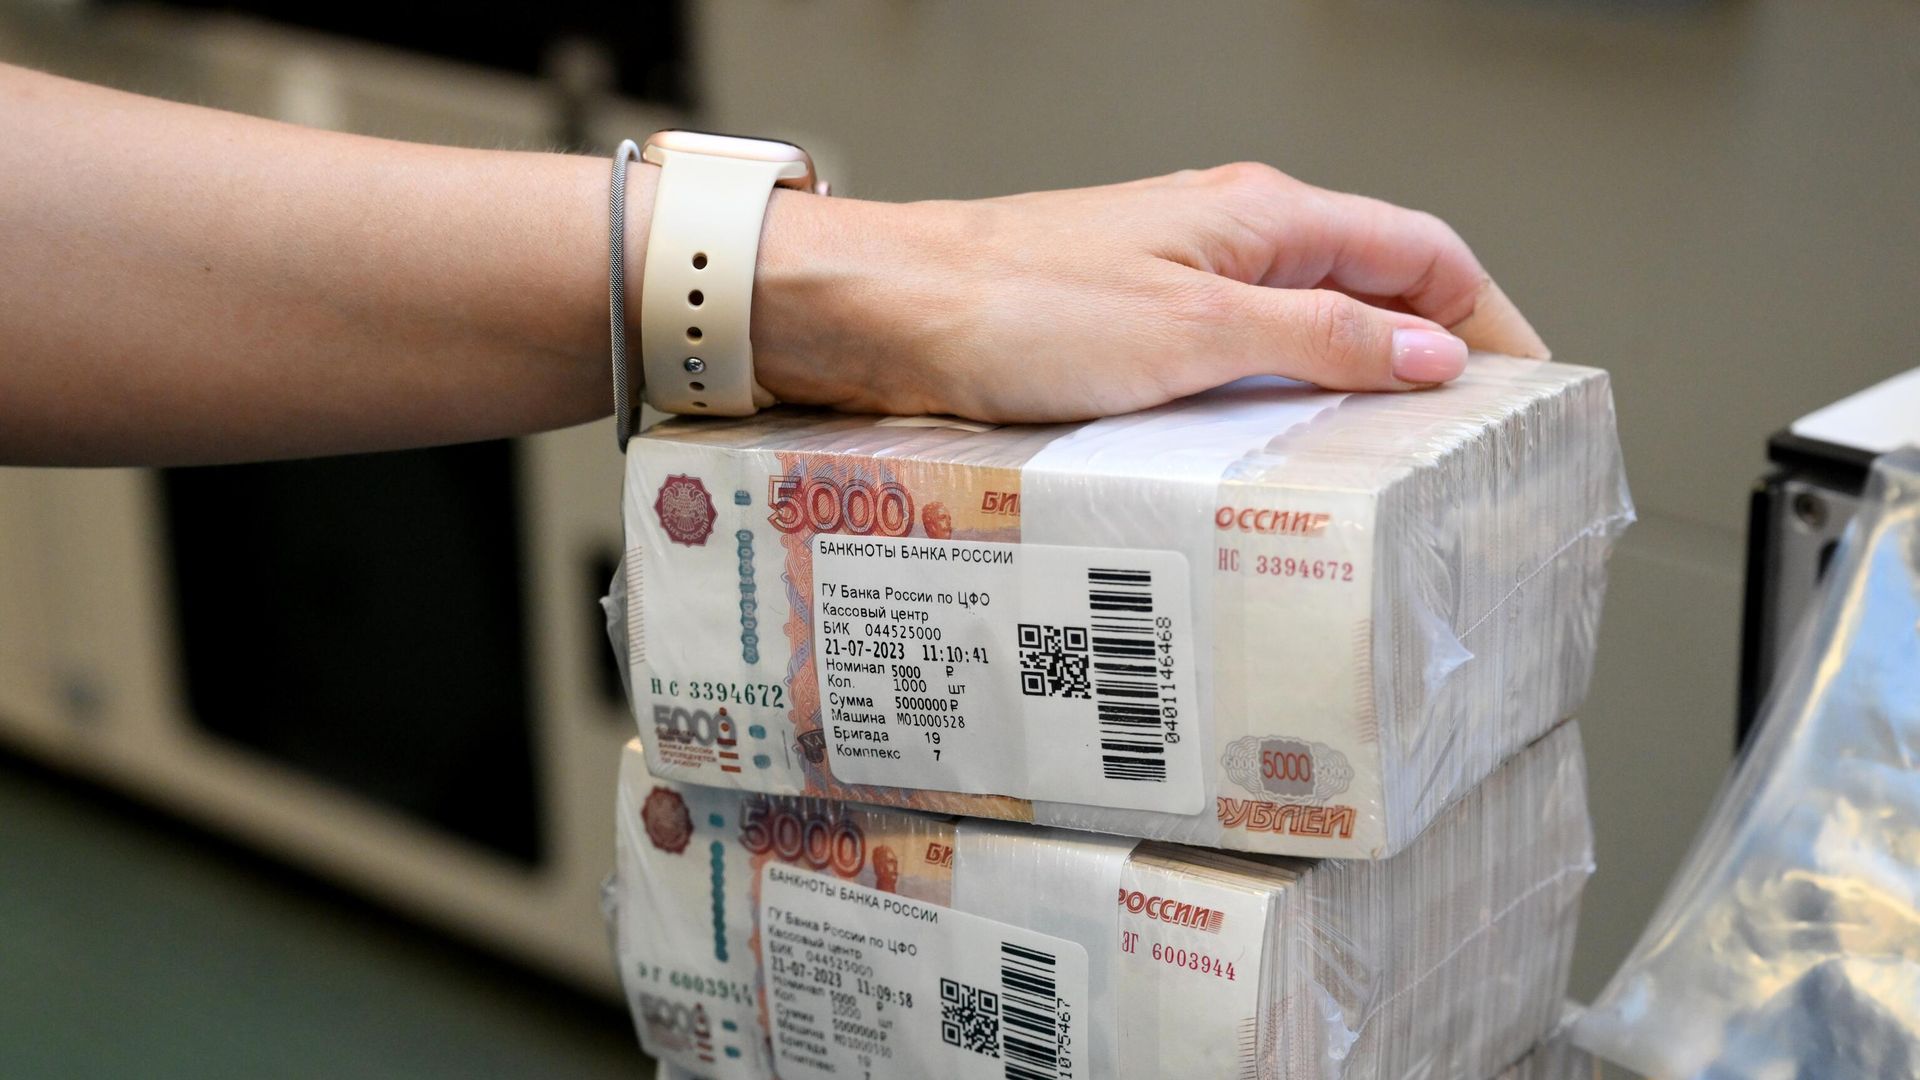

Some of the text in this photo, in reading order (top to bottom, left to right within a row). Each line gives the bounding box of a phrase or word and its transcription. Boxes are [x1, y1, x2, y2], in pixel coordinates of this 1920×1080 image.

[767, 475, 915, 537] 5000
[1215, 506, 1318, 536] ОССИИ
[820, 541, 1014, 564] БАНКНОТЫ БАНКА РОССИИ
[1256, 555, 1354, 582] 3394672
[821, 583, 990, 609] ГУ Банка России по ЦФО
[823, 603, 929, 624] Кассовый центр
[823, 621, 942, 641] БИК 044525000
[825, 638, 989, 664] 21-07-2023 11:10:41
[826, 658, 886, 674] Номинал
[891, 664, 921, 679] 5000
[1156, 616, 1180, 743] 0401146468
[689, 681, 784, 709] 3394672
[827, 674, 966, 695] Кол. 1000 шт
[829, 692, 874, 709] Сумма
[831, 708, 886, 725] Машина
[833, 726, 889, 743] Бригада
[924, 732, 941, 745] 19
[835, 744, 941, 761] Комплекс 7
[1262, 750, 1312, 782] 5000
[738, 796, 866, 878] 5000
[769, 867, 938, 924] БАНКНОТЫ БАНКА РОССИИ
[785, 912, 819, 932] Банка
[824, 922, 866, 944] России
[869, 937, 884, 949] по
[887, 938, 917, 957] ЦФО
[1152, 943, 1235, 981] 6003944
[857, 978, 913, 1009] 11:09:58
